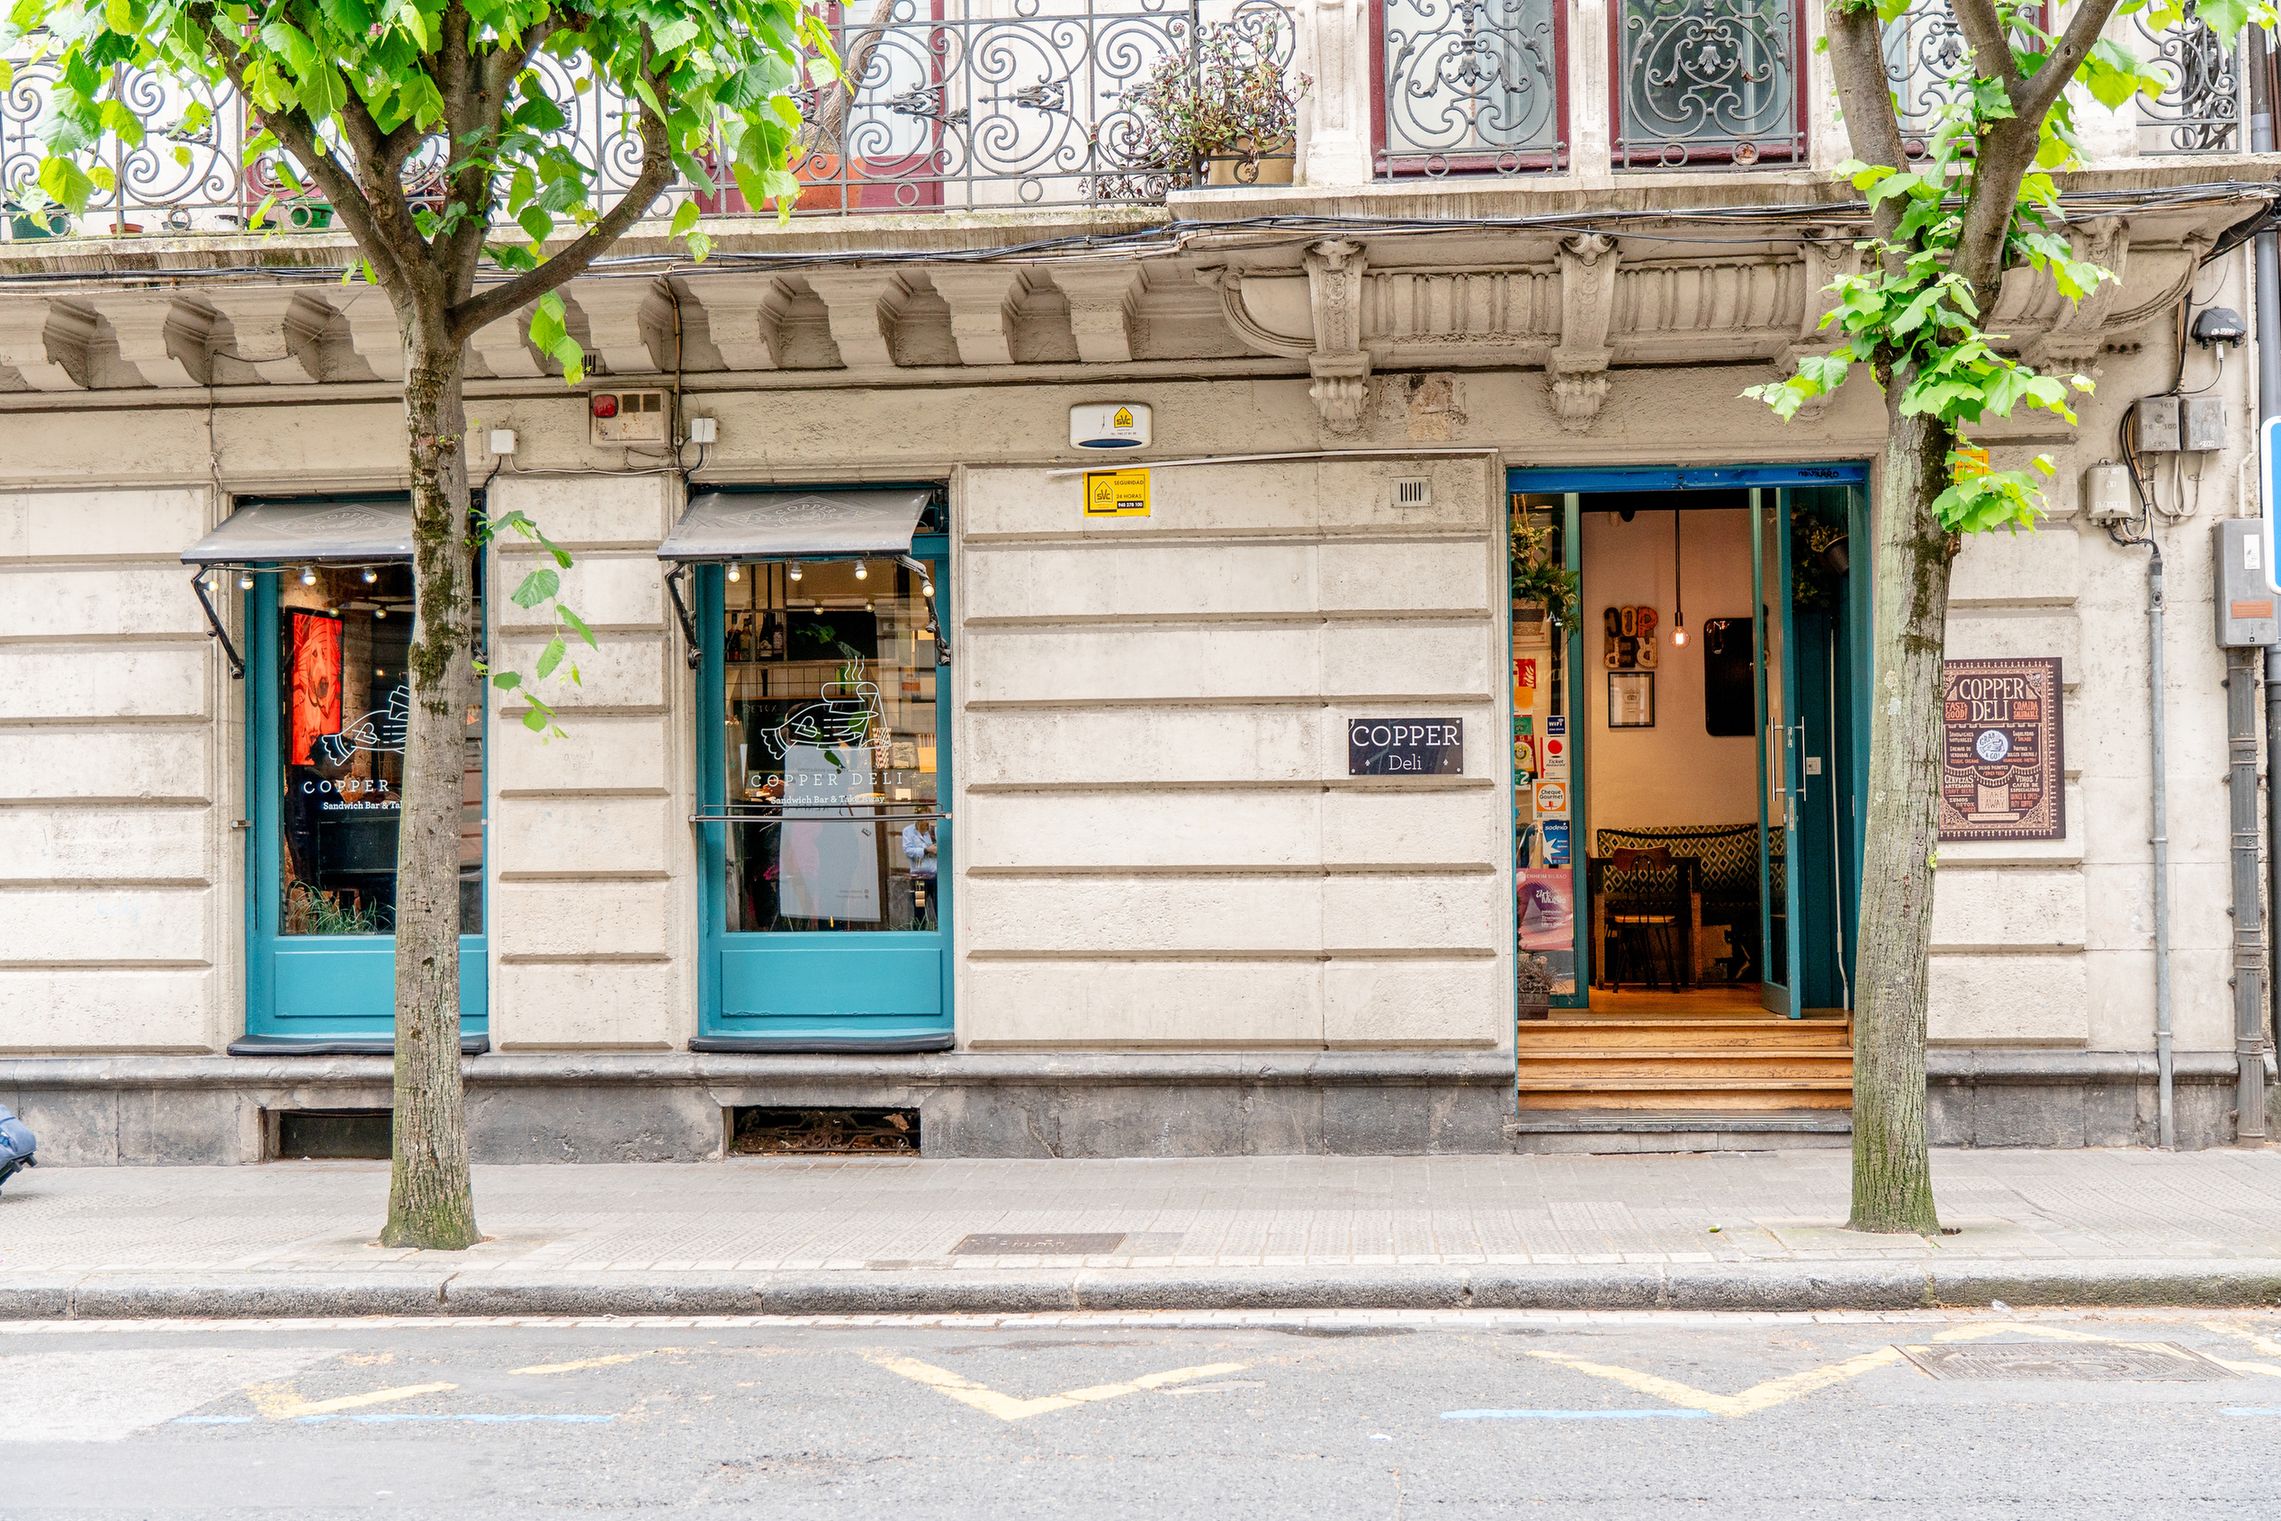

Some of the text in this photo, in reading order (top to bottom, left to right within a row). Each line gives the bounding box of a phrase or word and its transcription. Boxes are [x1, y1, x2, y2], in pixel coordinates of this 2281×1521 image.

[1959, 677, 2025, 700] COPPER
[1971, 700, 2009, 722] DELI
[2013, 701, 2038, 711] COMIDA
[1352, 725, 1460, 747] COPPER
[1388, 753, 1422, 771] Deli
[303, 779, 389, 794] COPPER
[751, 772, 903, 788] COPPER DELI
[1944, 774, 1974, 784] CERVEZAS
[323, 801, 364, 810] Sandwich
[365, 801, 379, 810] Bar
[381, 801, 389, 810] &
[770, 795, 813, 805] Sandwich
[813, 795, 829, 804] Bar
[830, 795, 838, 804] &
[1545, 823, 1568, 831] sodexo
